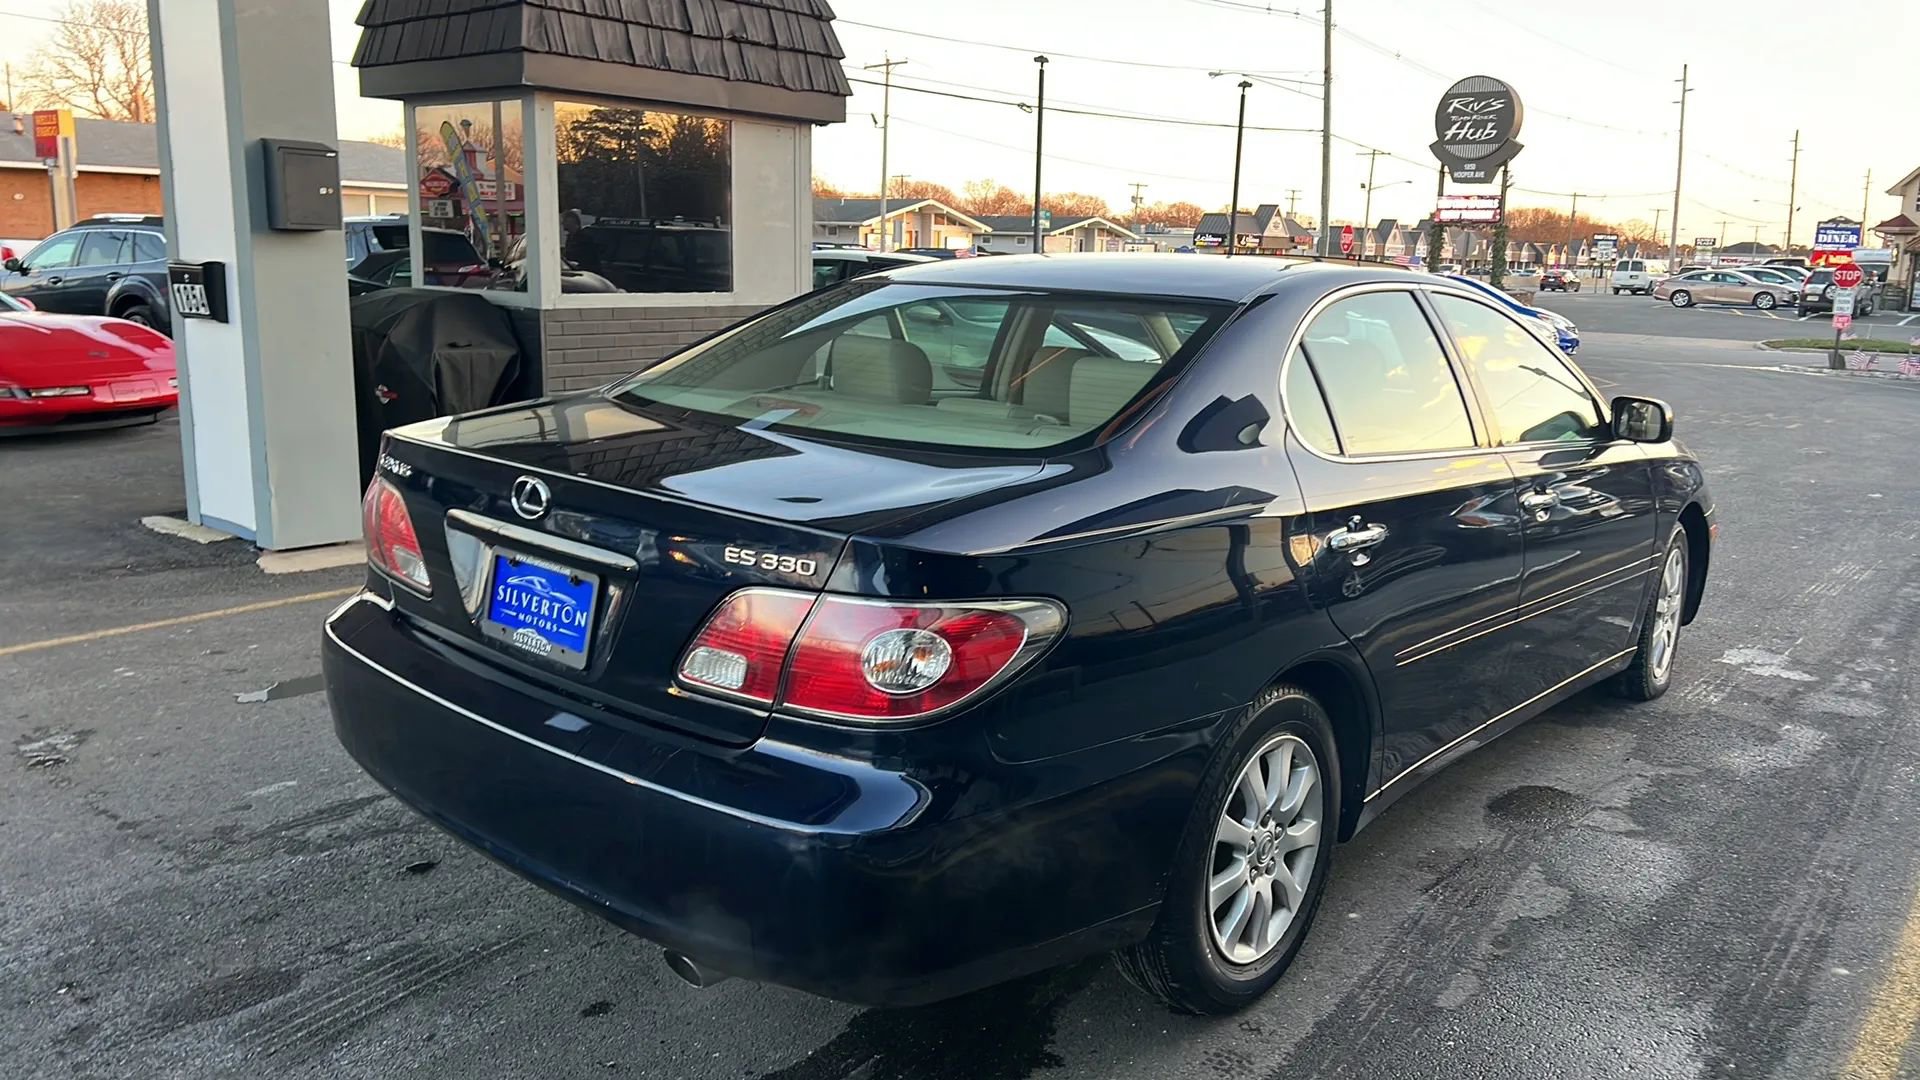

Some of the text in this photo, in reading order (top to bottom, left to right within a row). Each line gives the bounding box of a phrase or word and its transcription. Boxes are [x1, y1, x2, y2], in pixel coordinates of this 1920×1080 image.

[1444, 121, 1497, 141] Hub
[1818, 234, 1858, 243] DINER
[1599, 251, 1610, 259] 35
[1834, 271, 1861, 280] STOP
[724, 546, 817, 576] ES 330
[497, 584, 588, 628] SILVERTON
[518, 612, 558, 632] MOTORS
[512, 631, 552, 652] SILVERTON
